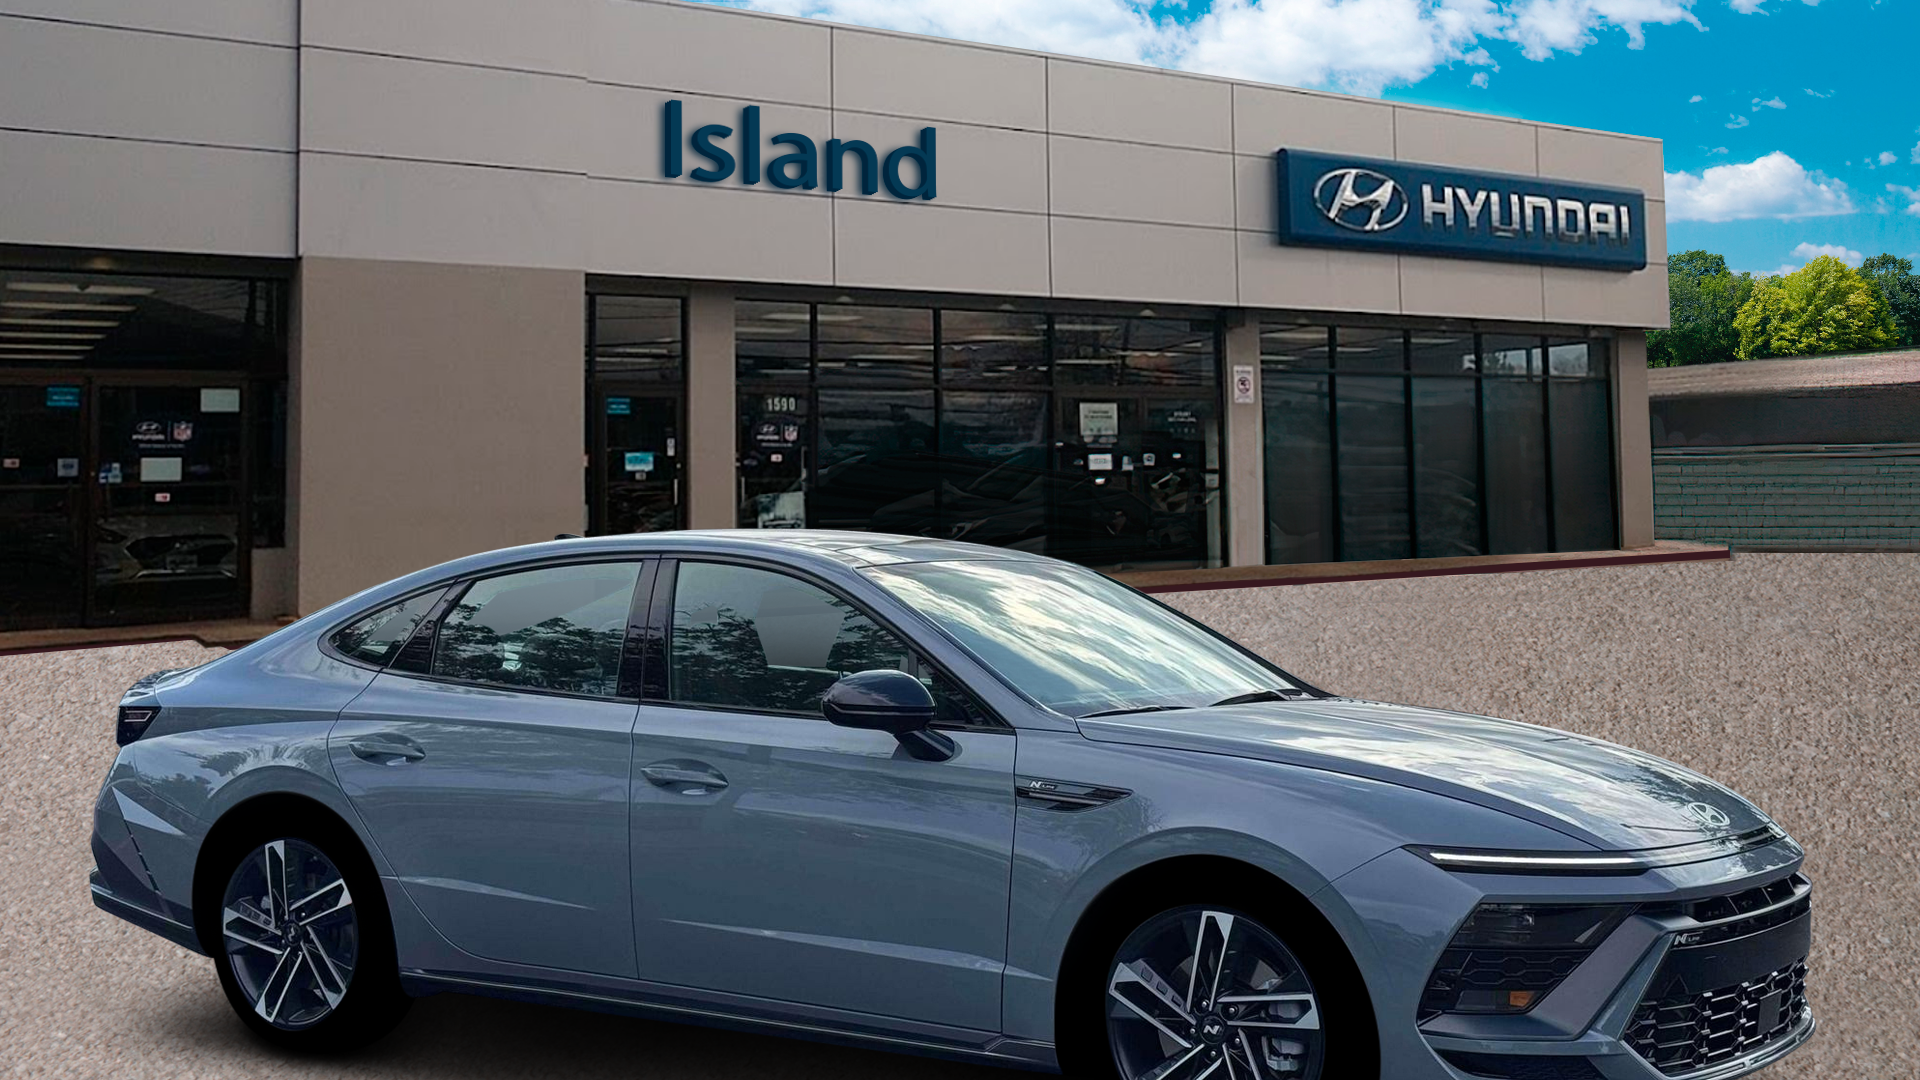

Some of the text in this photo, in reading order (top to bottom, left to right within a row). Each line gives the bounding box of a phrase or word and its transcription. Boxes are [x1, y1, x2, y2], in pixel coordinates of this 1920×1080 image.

[663, 99, 937, 201] Island
[1421, 184, 1630, 244] HYUNDAI
[767, 397, 796, 412] 1590
[1204, 1025, 1221, 1035] N
